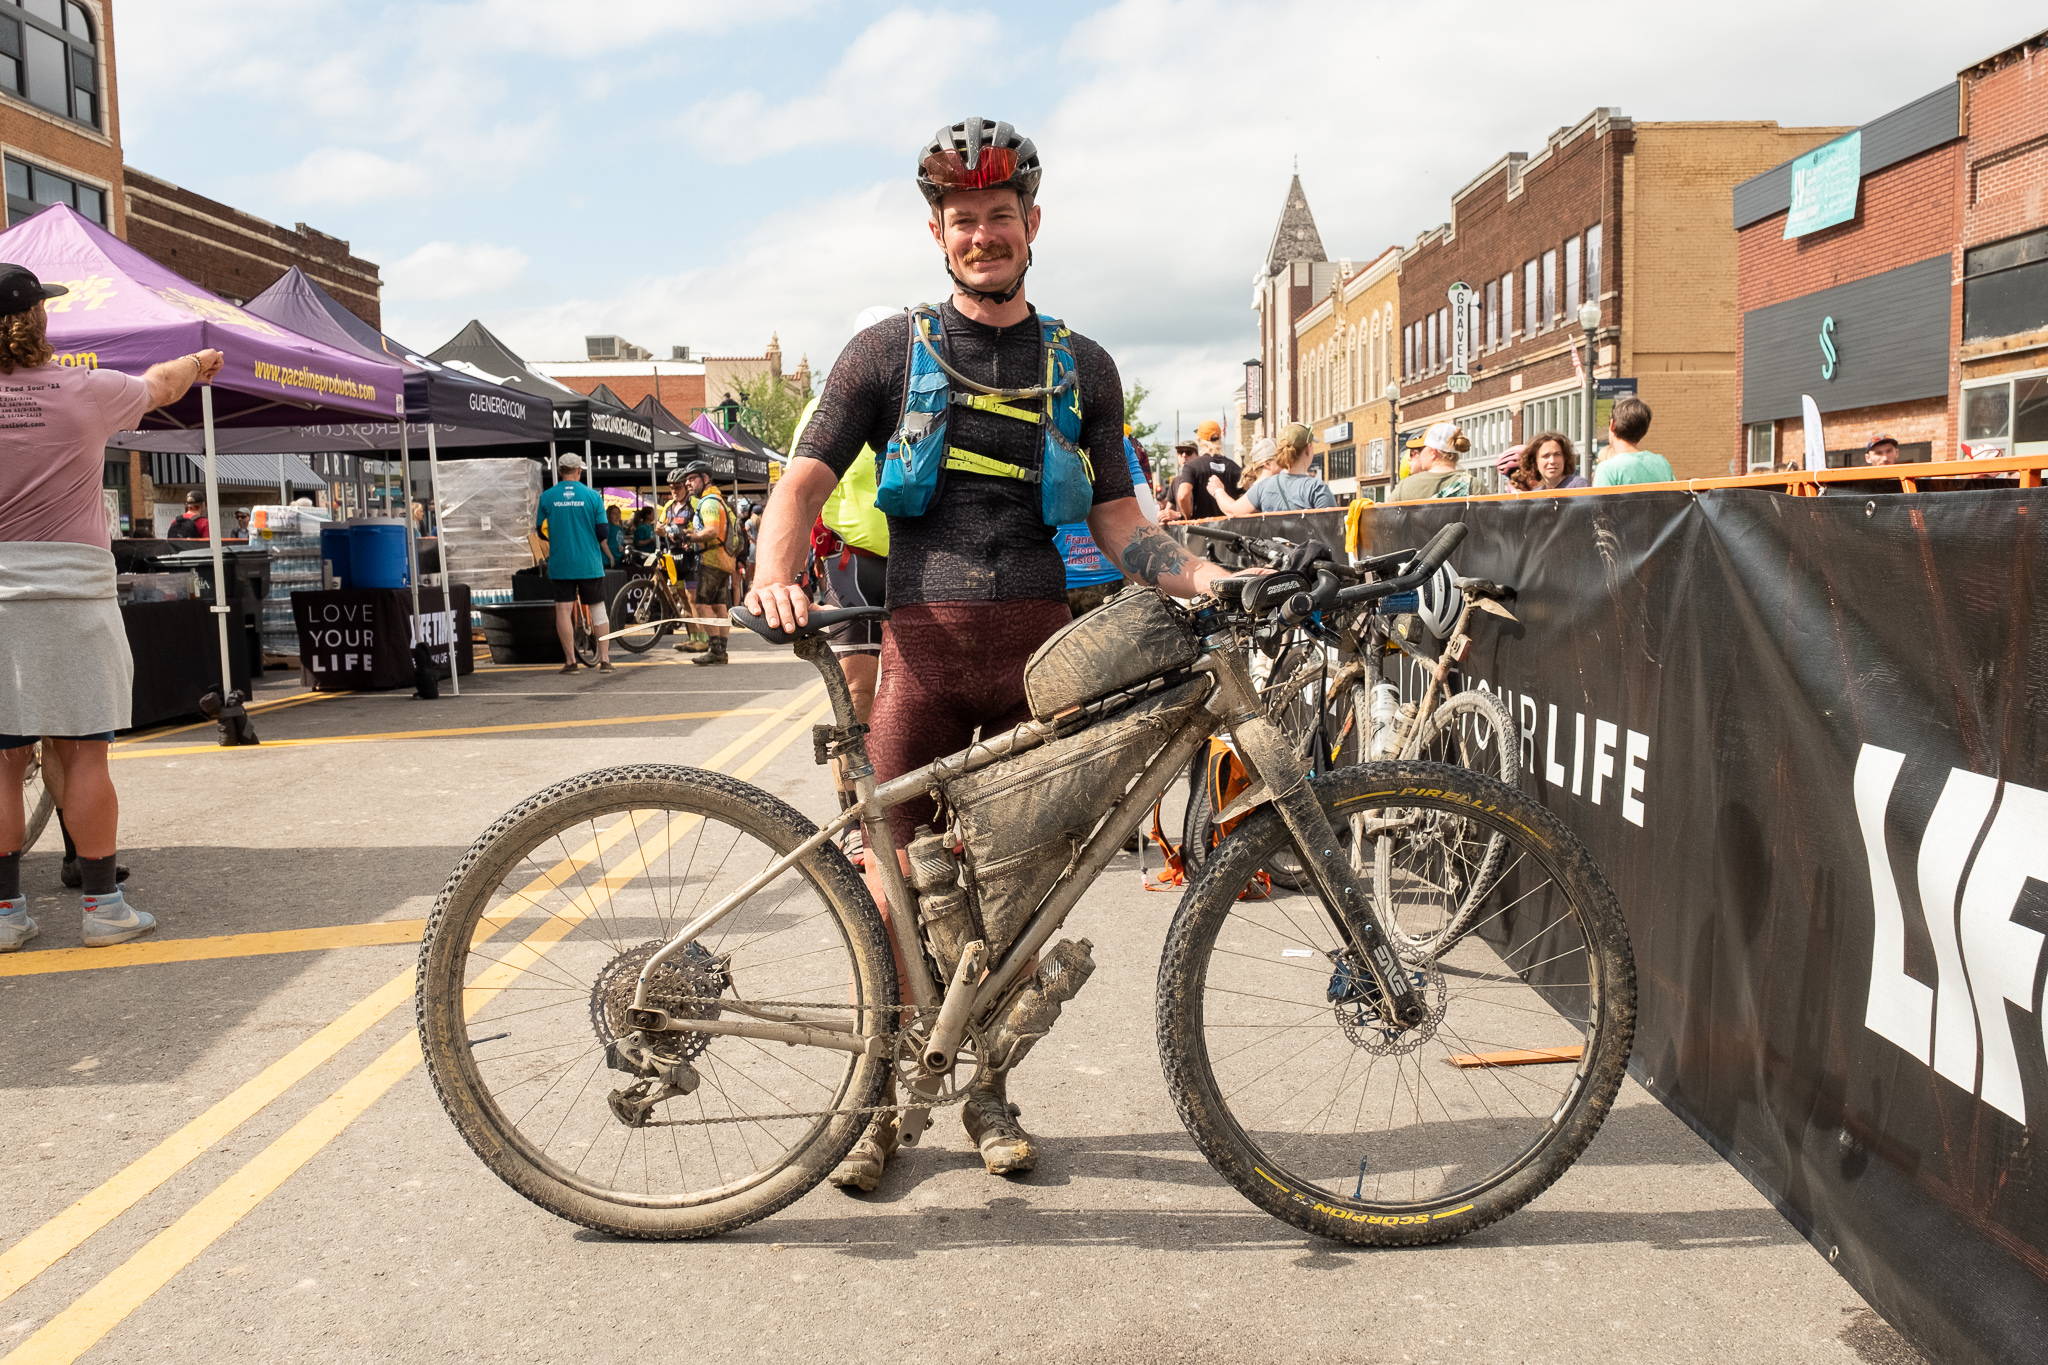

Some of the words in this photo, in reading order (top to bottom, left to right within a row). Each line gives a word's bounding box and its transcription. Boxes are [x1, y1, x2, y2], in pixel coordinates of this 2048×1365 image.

[1456, 292, 1465, 369] GRAVEL
[254, 359, 376, 401] www.pacelineproducts.com
[1449, 376, 1470, 389] CITY
[469, 392, 526, 420] GUENERGY.COM
[617, 451, 679, 468] LIFE
[1067, 554, 1099, 565] Inside
[1069, 545, 1097, 556] From
[308, 604, 373, 623] LOVE
[309, 629, 374, 648] YOUR
[312, 653, 373, 673] LIFE
[1545, 703, 1650, 828] LIFE
[1400, 787, 1498, 813] PIRELLI
[1853, 742, 2048, 1127] LIF
[1313, 1202, 1430, 1226] SCORPION
